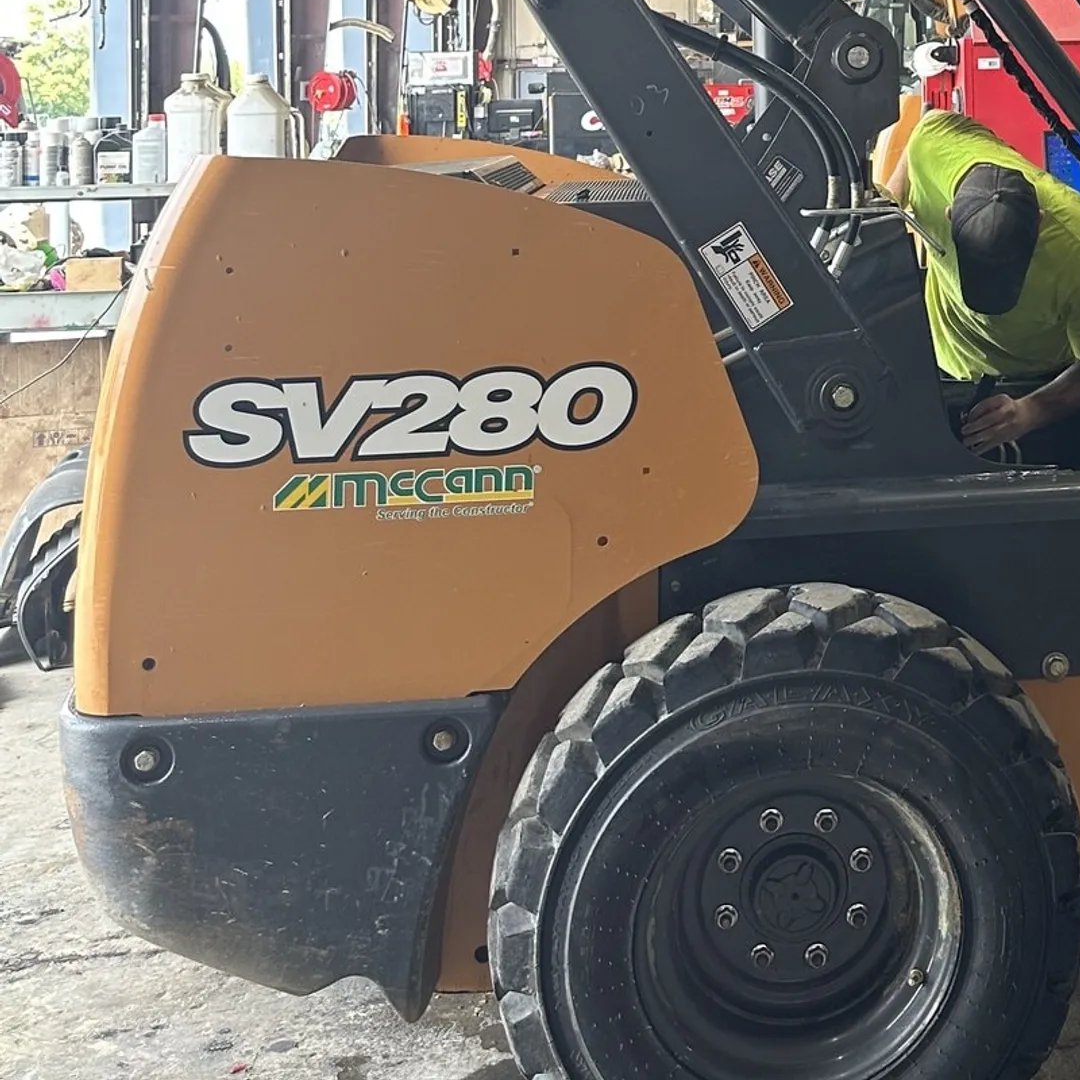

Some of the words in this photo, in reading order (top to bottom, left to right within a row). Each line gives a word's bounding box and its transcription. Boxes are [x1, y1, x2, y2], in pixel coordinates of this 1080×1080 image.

[759, 268, 786, 305] WARNING
[183, 361, 638, 469] SV280
[376, 508, 426, 521] Serving
[428, 506, 450, 518] the
[452, 502, 530, 517] Constructor
